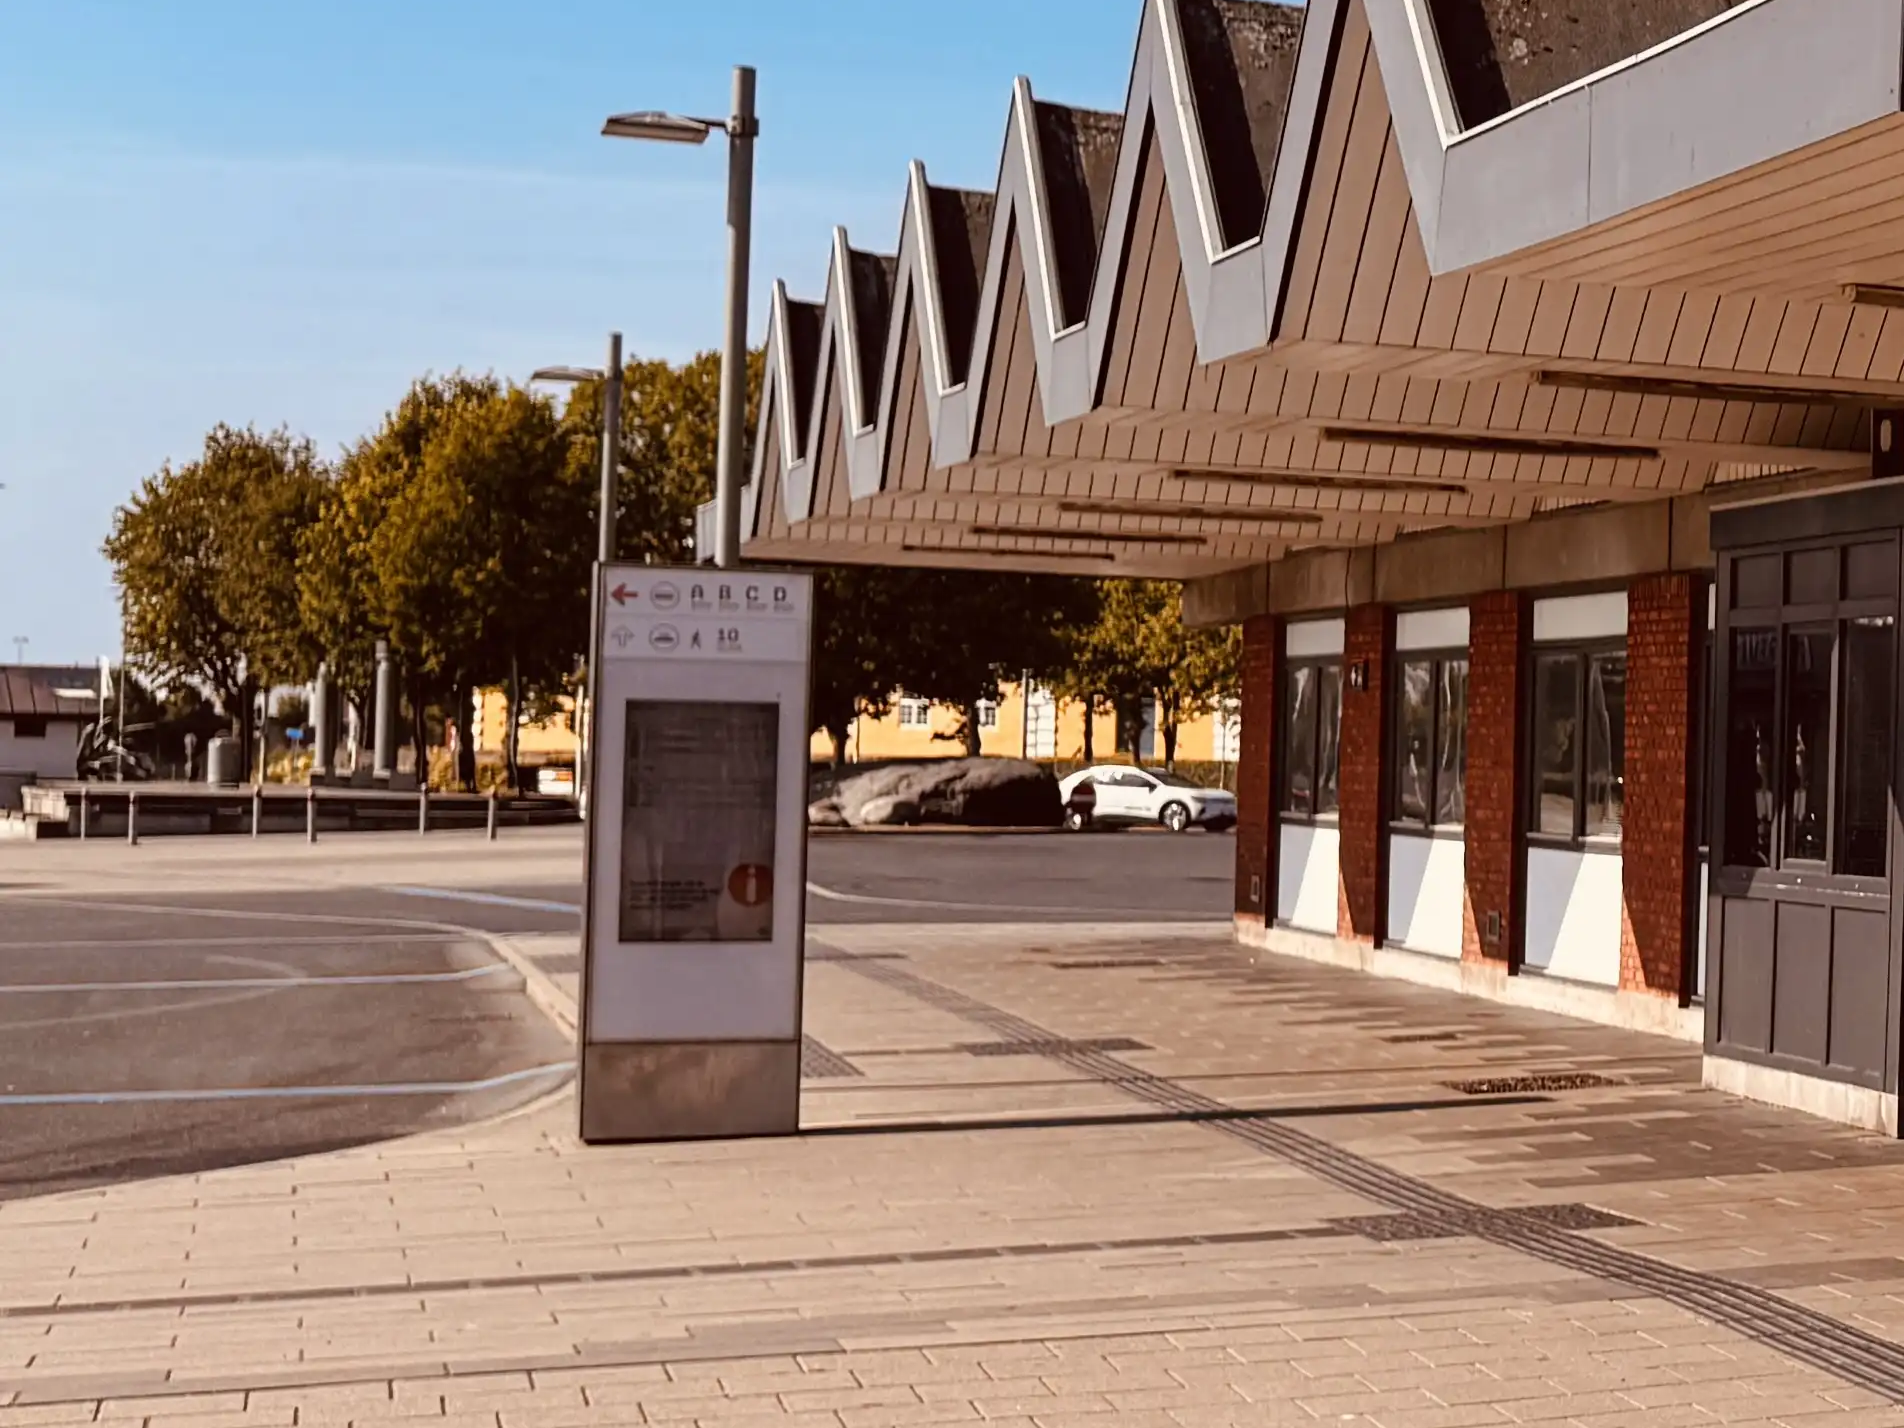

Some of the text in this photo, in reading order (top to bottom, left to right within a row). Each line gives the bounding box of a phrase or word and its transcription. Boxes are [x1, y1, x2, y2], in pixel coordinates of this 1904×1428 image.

[690, 584, 788, 602] A B C D
[717, 627, 740, 643] 10
